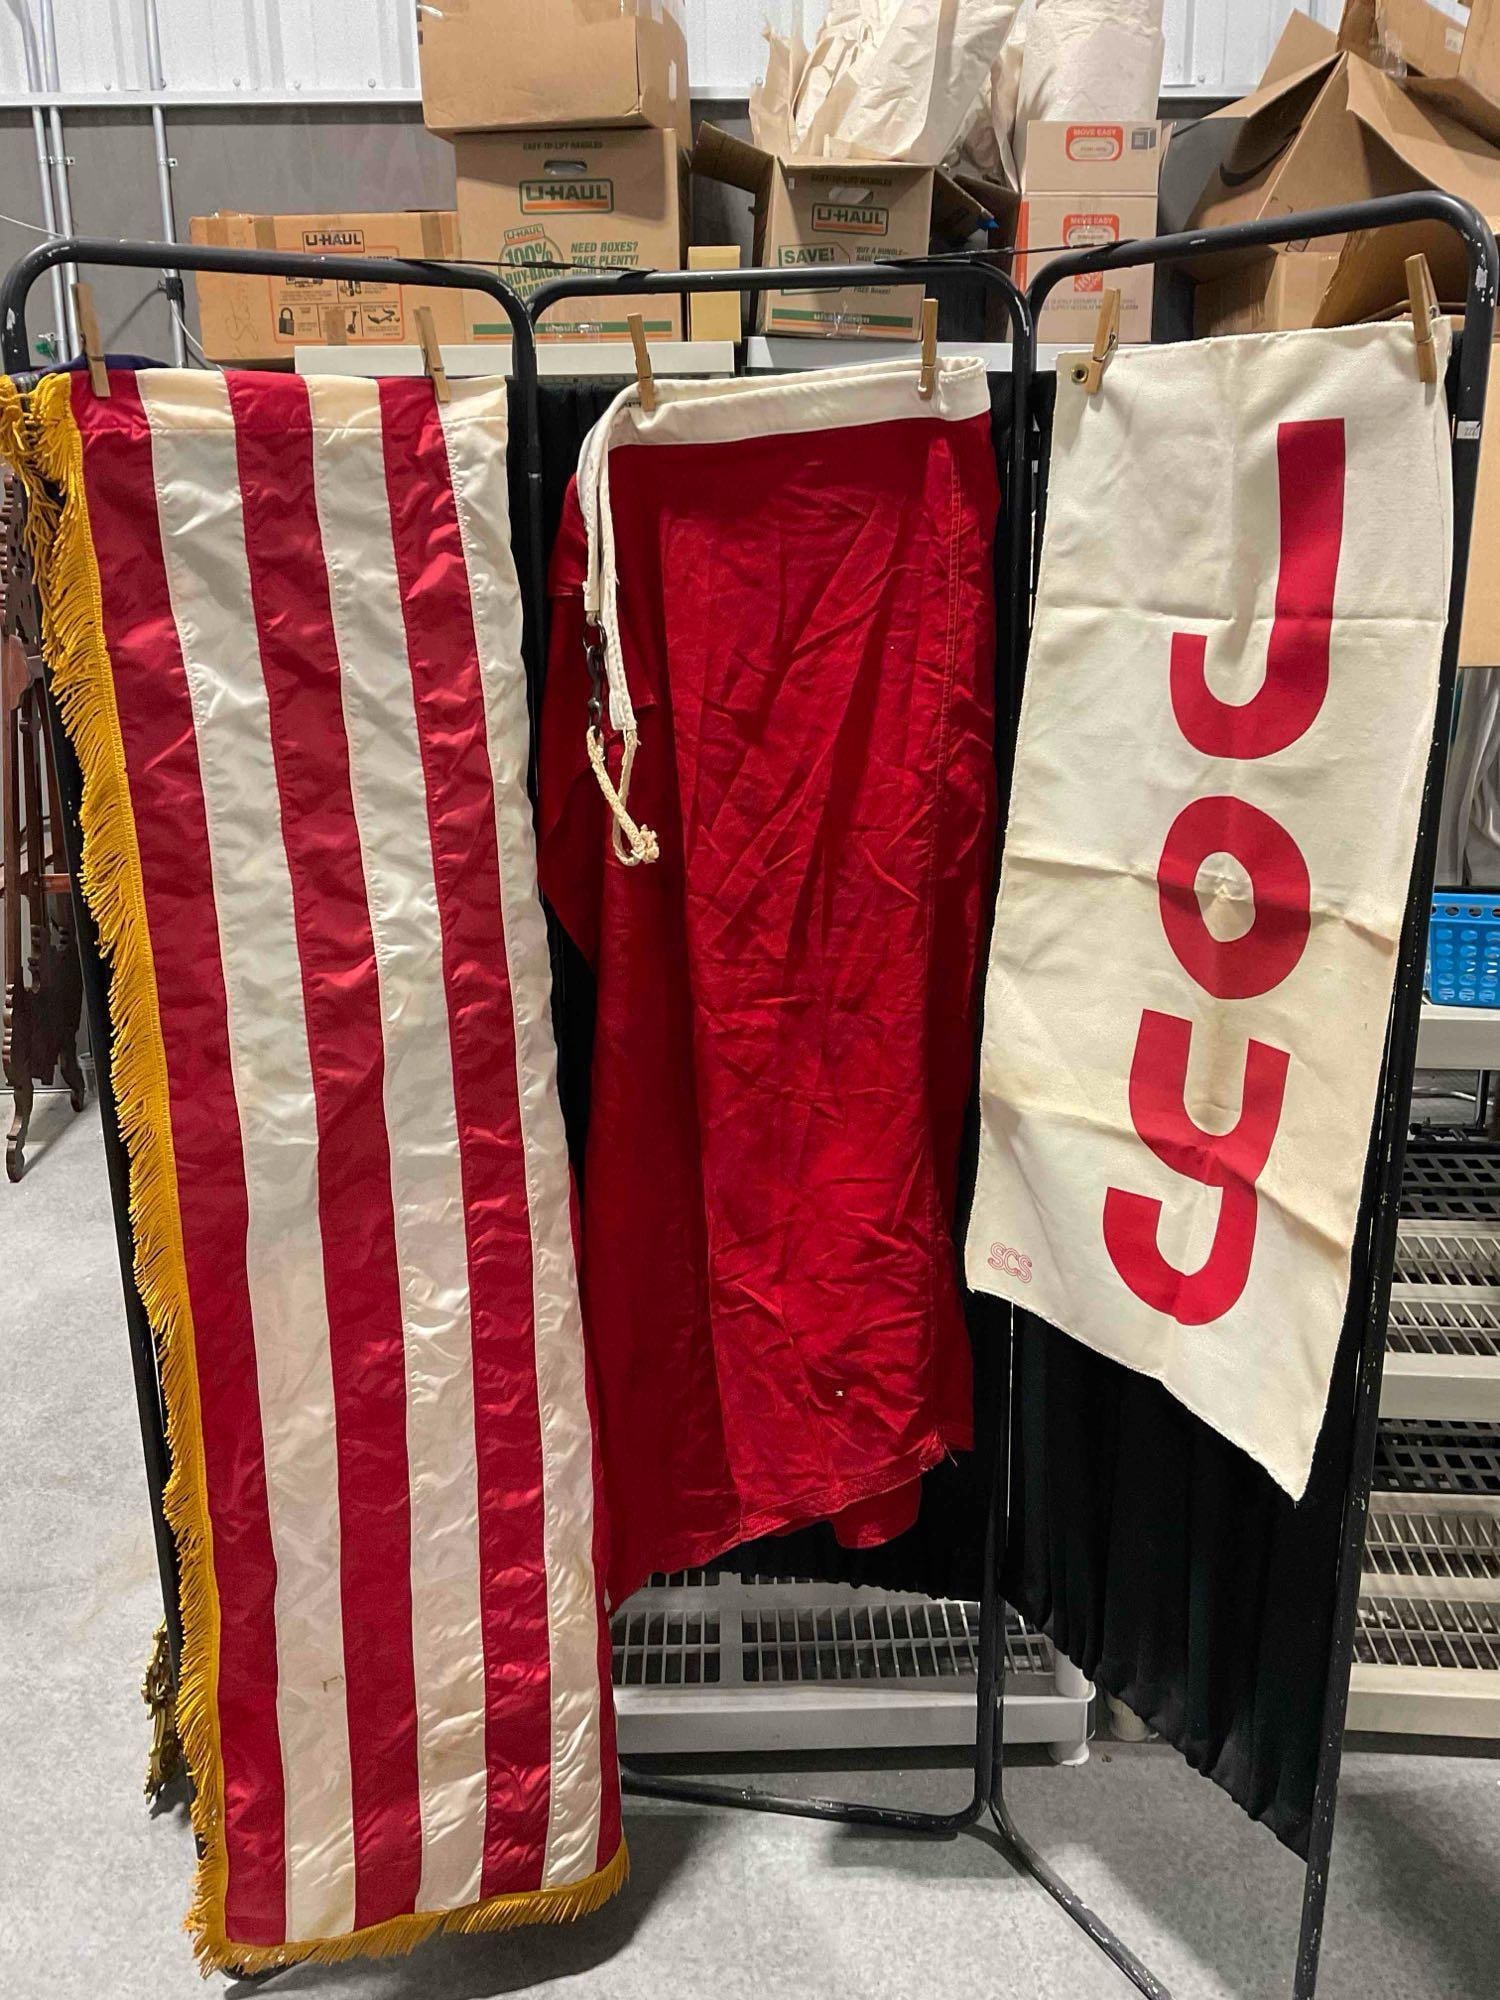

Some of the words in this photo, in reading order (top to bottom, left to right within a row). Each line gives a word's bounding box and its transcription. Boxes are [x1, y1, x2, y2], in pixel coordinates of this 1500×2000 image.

[1074, 128, 1095, 136] MOVE
[1097, 127, 1117, 136] EASY
[525, 184, 608, 201] U-HAUL
[817, 207, 884, 225] U-HAUL
[1070, 217, 1092, 225] MOVE
[1093, 217, 1113, 225] EASY
[305, 232, 362, 246] U-HAUL
[507, 225, 542, 241] U-HAUL
[505, 241, 554, 270] 100%
[571, 242, 598, 254] NEED
[600, 241, 639, 253] BOXES?
[572, 255, 597, 267] TAKE
[600, 255, 640, 267] PLENTY!
[784, 247, 835, 265] SAVE!
[987, 1241, 1032, 1284] SCS
